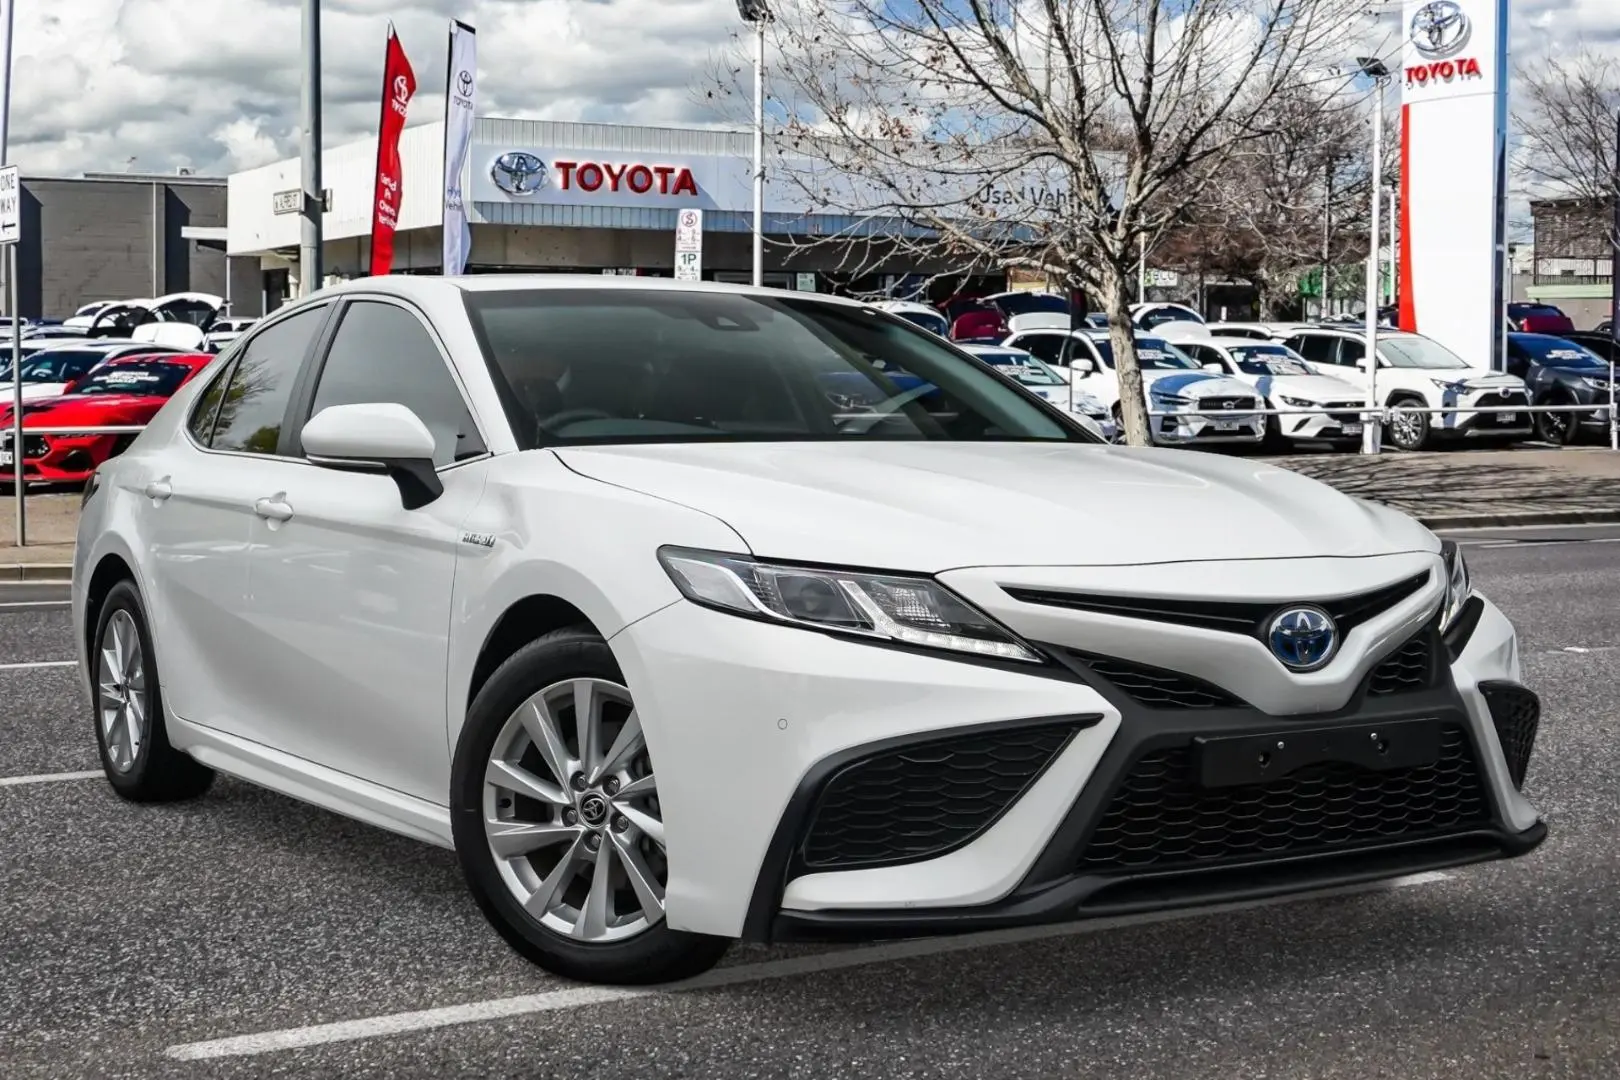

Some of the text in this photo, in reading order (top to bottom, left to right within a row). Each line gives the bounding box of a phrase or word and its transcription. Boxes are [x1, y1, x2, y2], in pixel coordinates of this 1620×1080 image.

[1404, 59, 1480, 83] TOYOTA
[0, 173, 15, 191] ONE
[555, 161, 698, 196] TOYOTA
[681, 253, 697, 265] 1P
